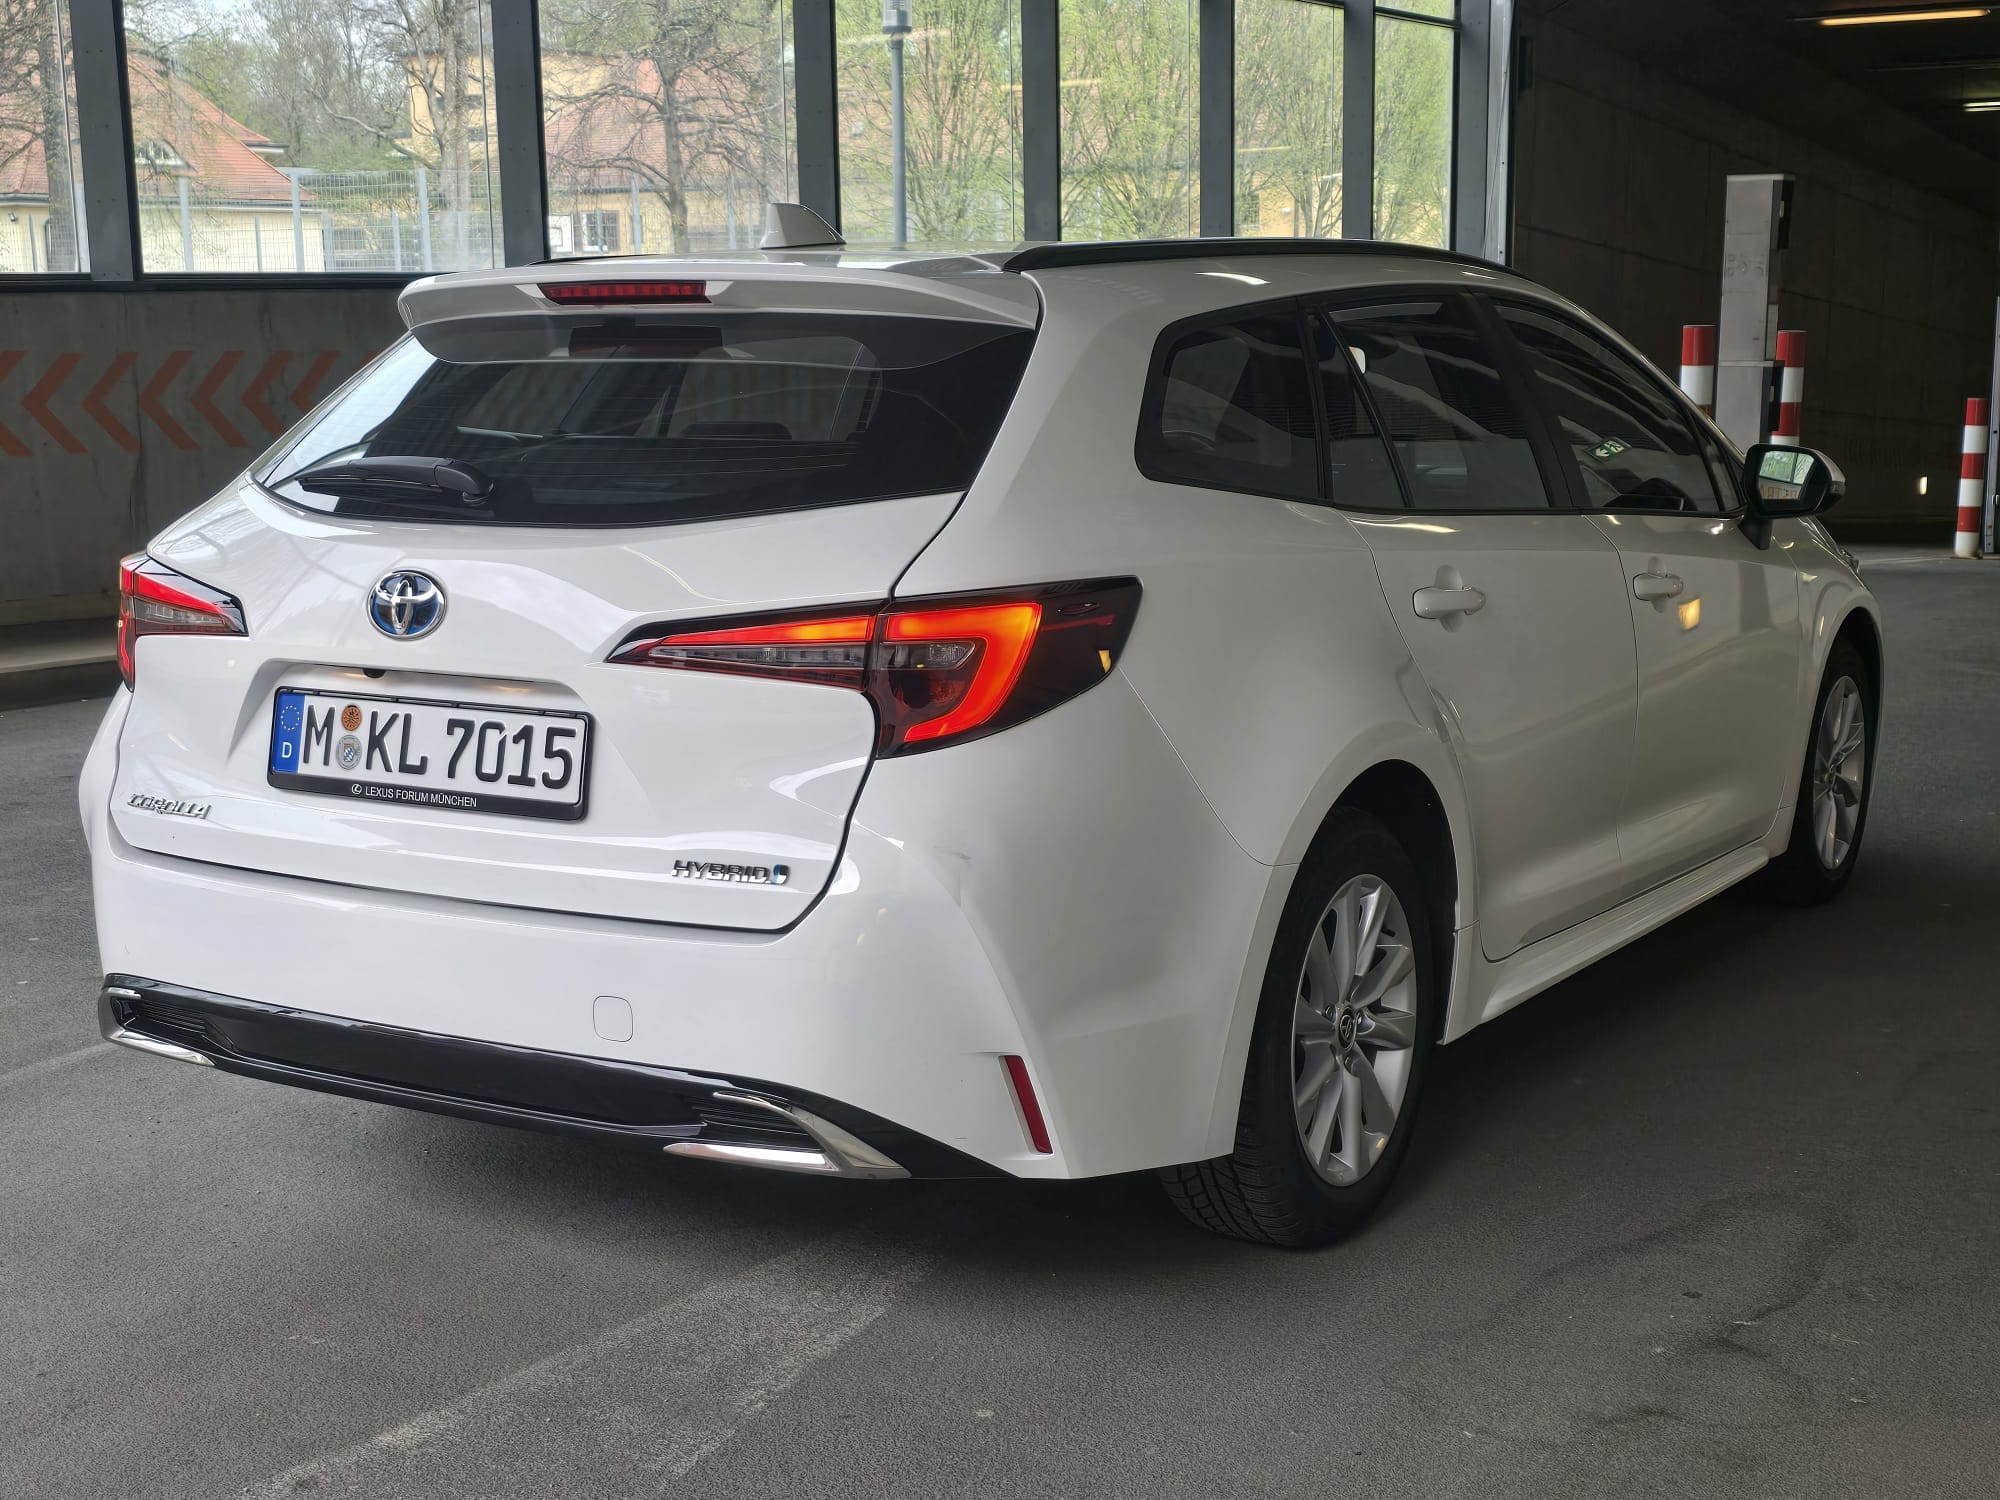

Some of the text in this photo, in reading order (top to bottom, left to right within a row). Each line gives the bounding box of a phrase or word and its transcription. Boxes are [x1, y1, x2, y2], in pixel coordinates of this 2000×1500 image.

[281, 742, 292, 758] D
[303, 705, 335, 766] M
[366, 711, 428, 775] KL
[447, 718, 576, 789] 7015
[365, 786, 477, 807] LEXUS FORUM MÜNCHEN
[672, 860, 771, 884] HYBRID
